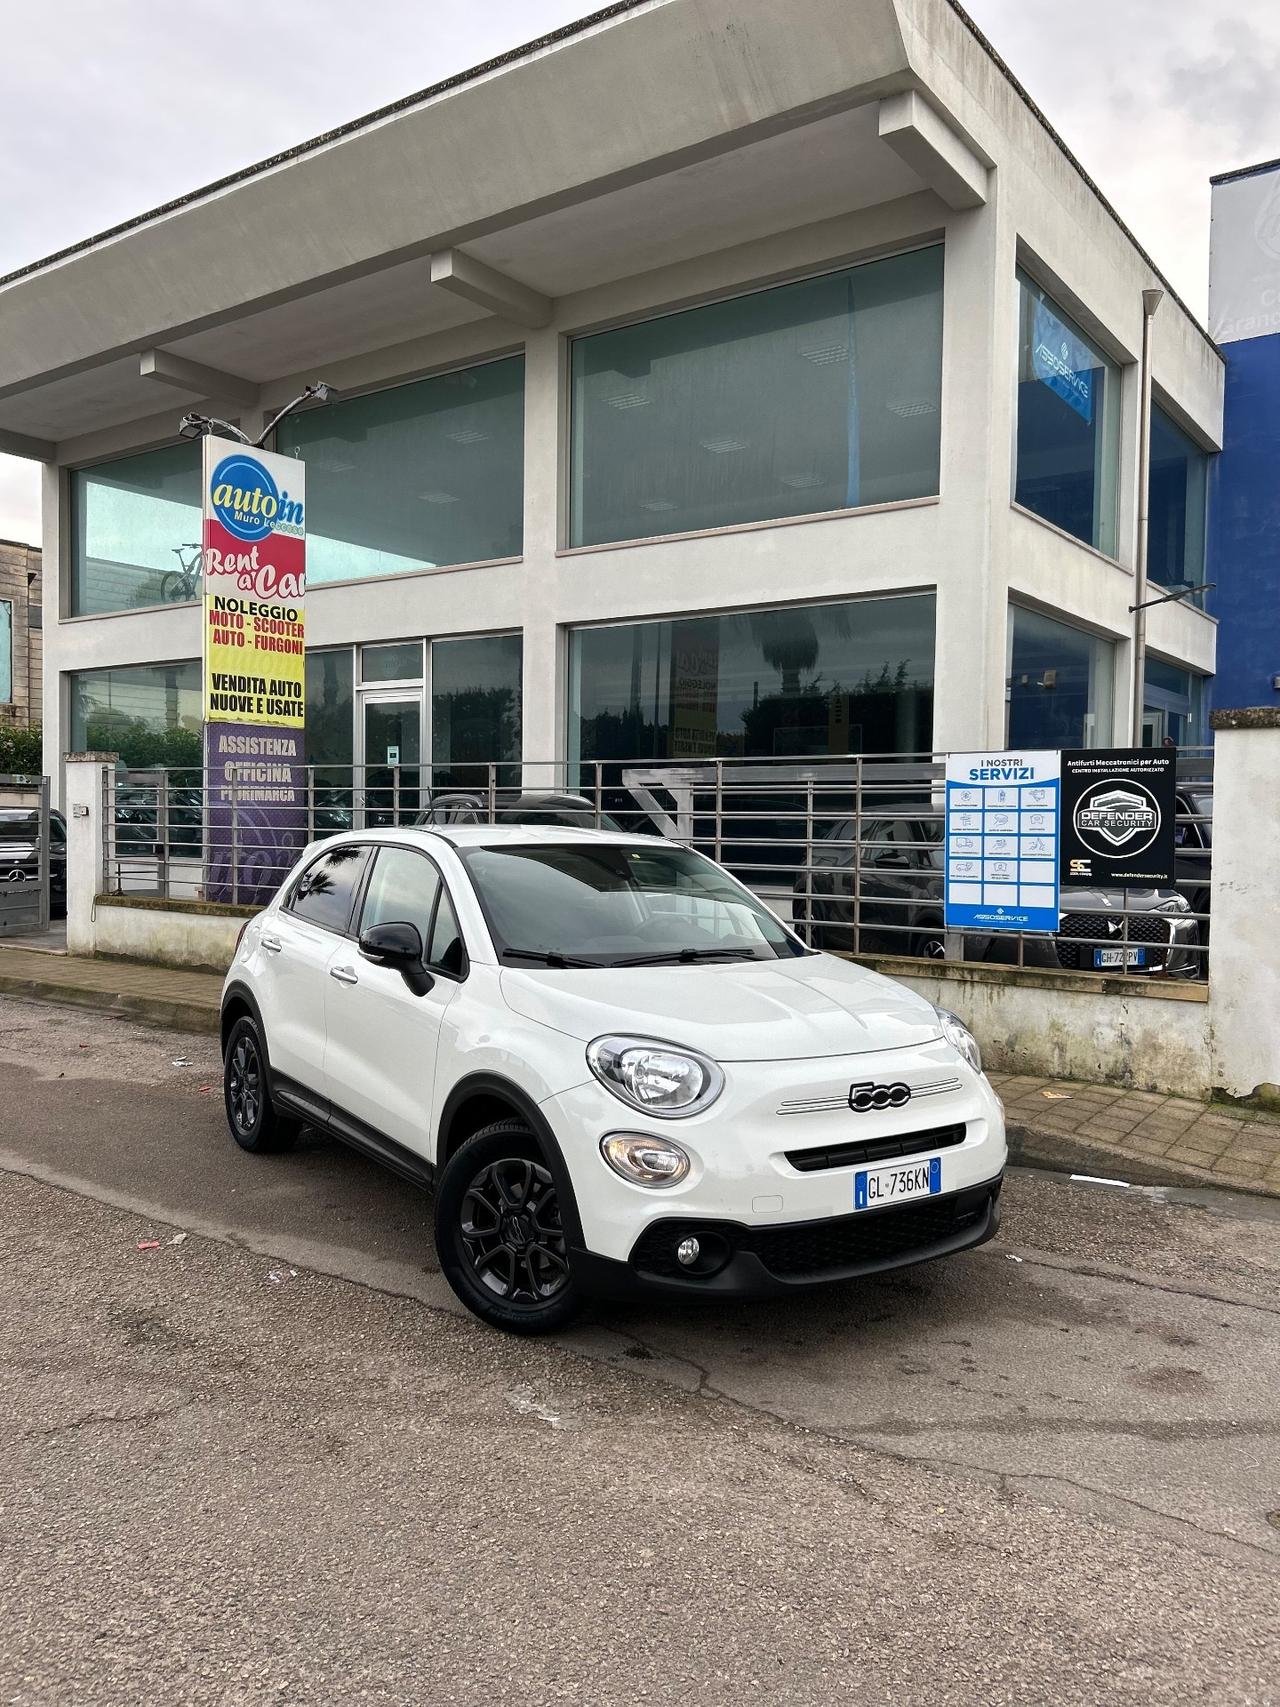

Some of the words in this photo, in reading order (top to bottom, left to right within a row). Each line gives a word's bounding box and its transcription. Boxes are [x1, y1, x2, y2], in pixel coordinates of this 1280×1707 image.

[234, 510, 260, 525] Muro
[206, 545, 260, 575] Rent
[214, 596, 298, 622] NOLEGGIO
[209, 610, 244, 629] MOTO
[254, 617, 304, 638] SCOOTER
[213, 629, 245, 648] AUTO
[255, 635, 303, 655] FURGONI
[211, 672, 267, 695] VENDITA
[269, 679, 302, 699] AUTO
[210, 692, 254, 713] NUOVE
[256, 697, 264, 714] E
[266, 698, 304, 718] USATE
[218, 735, 297, 757] ASSISTENZA
[969, 767, 1035, 781] SERVIZI
[986, 758, 1023, 767] NOSTRI
[1067, 759, 1095, 767] Antifurti
[1095, 758, 1139, 766] Meccatronici
[1140, 759, 1152, 767] per
[1081, 812, 1153, 820] DEFENDER
[1081, 819, 1100, 827] CAR
[1104, 819, 1153, 827] SECURITY
[848, 1081, 911, 1113] 500
